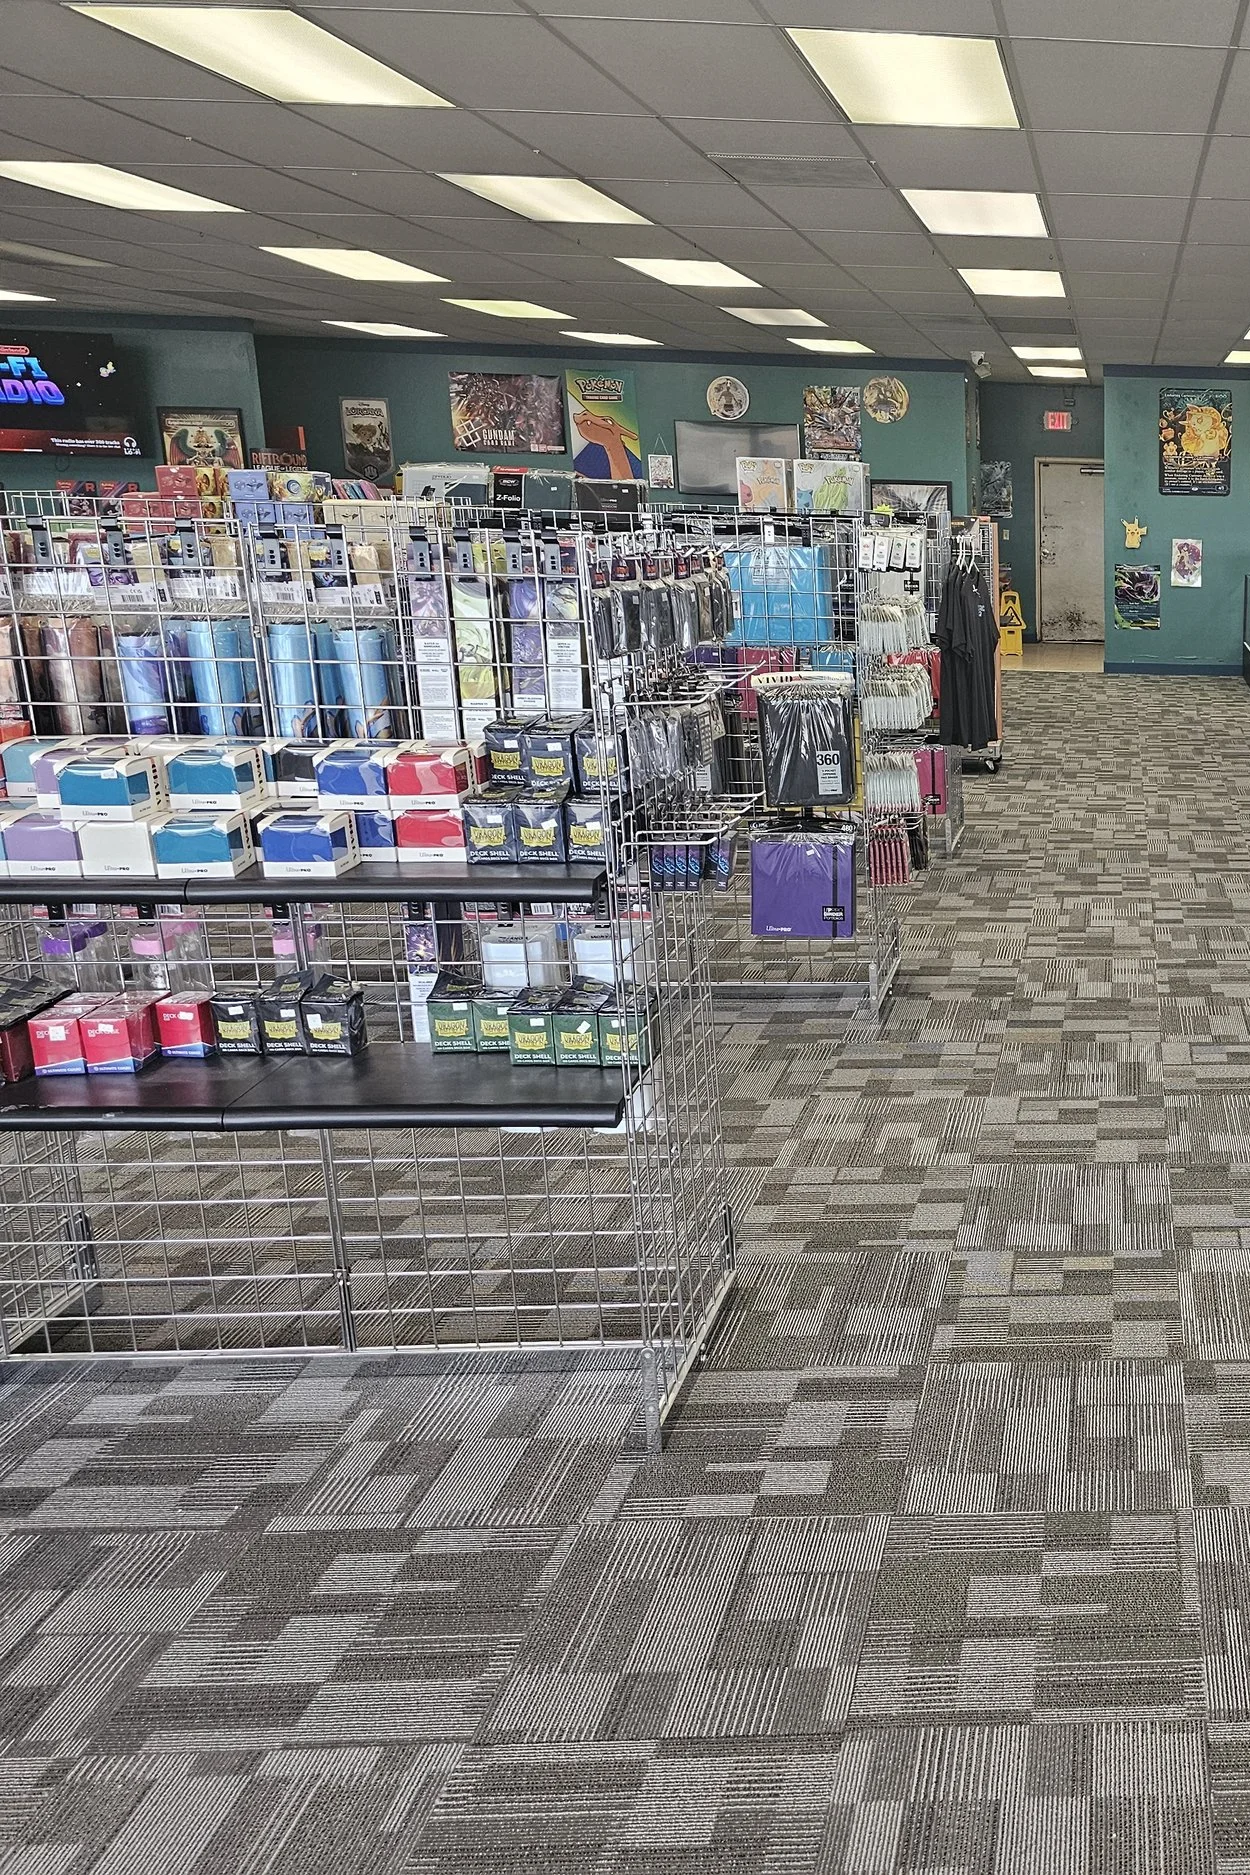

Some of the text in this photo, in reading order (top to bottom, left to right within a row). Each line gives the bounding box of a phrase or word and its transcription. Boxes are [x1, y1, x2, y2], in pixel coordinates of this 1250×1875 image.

[1048, 411, 1068, 430] EXIT
[482, 429, 515, 441] GUNDAM
[251, 452, 307, 466] RIFTBOUND
[496, 493, 521, 502] Z-Folio
[816, 753, 840, 766] 360
[310, 1042, 327, 1050] DECK
